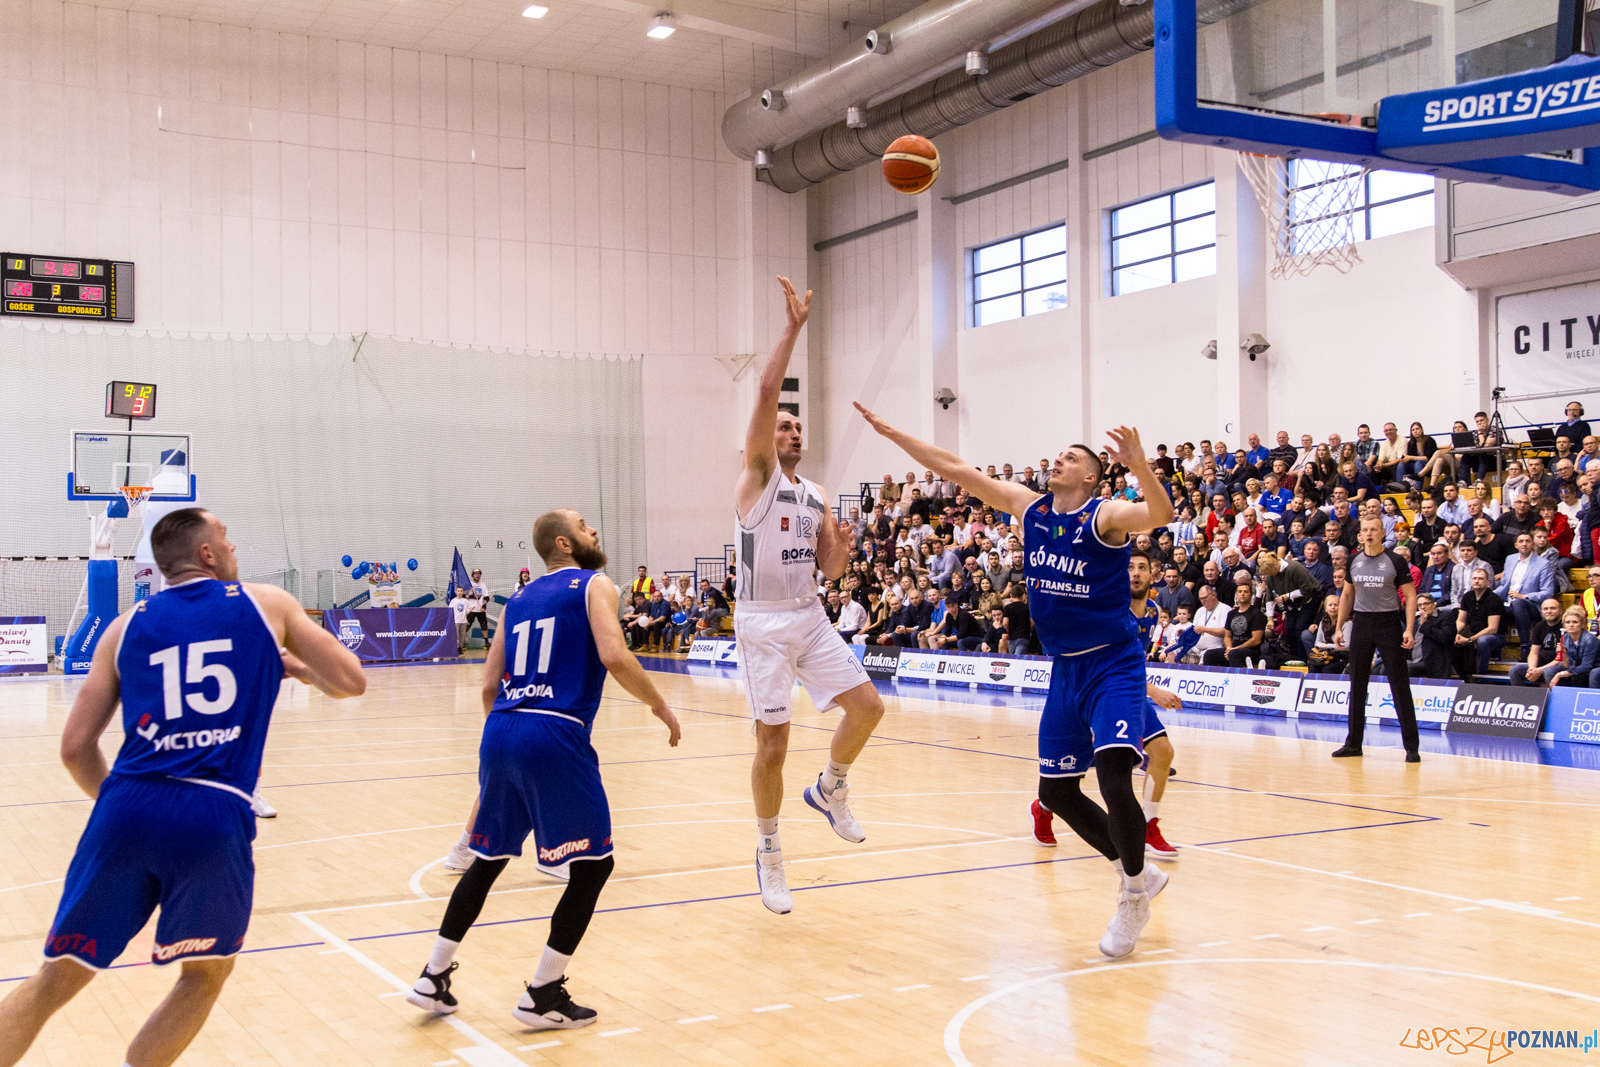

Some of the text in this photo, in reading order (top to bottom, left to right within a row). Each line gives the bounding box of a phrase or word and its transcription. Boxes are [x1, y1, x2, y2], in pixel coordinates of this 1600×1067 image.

[14, 259, 23, 270] 0
[88, 265, 97, 275] 0
[52, 284, 61, 295] 3
[9, 301, 102, 315] GOŚCIE GOSPODARZE
[1514, 314, 1600, 355] CITY
[1565, 349, 1595, 359] WIĘCEJ
[124, 384, 152, 399] 9:12
[132, 397, 147, 415] 3
[796, 516, 813, 538] 12
[1072, 526, 1083, 544] 2
[474, 540, 526, 549] A B C
[1029, 545, 1088, 577] GÓRNIK
[1354, 574, 1384, 582] VERONI
[80, 616, 101, 653] HYDROPLAY
[376, 629, 447, 638] www.basket.poznan.pl
[512, 616, 556, 676] 11
[863, 652, 898, 667] drukma
[910, 659, 935, 670] funclub
[947, 663, 975, 675] NICKEL
[149, 638, 238, 720] 15
[1253, 686, 1275, 695] JOKER
[1454, 695, 1539, 720] drukma
[1115, 719, 1129, 739] 2
[1452, 716, 1536, 729] DRUKARNIA SKOCZYŃSKI
[153, 725, 242, 752] VICTORIA
[539, 838, 590, 862] SPORTING
